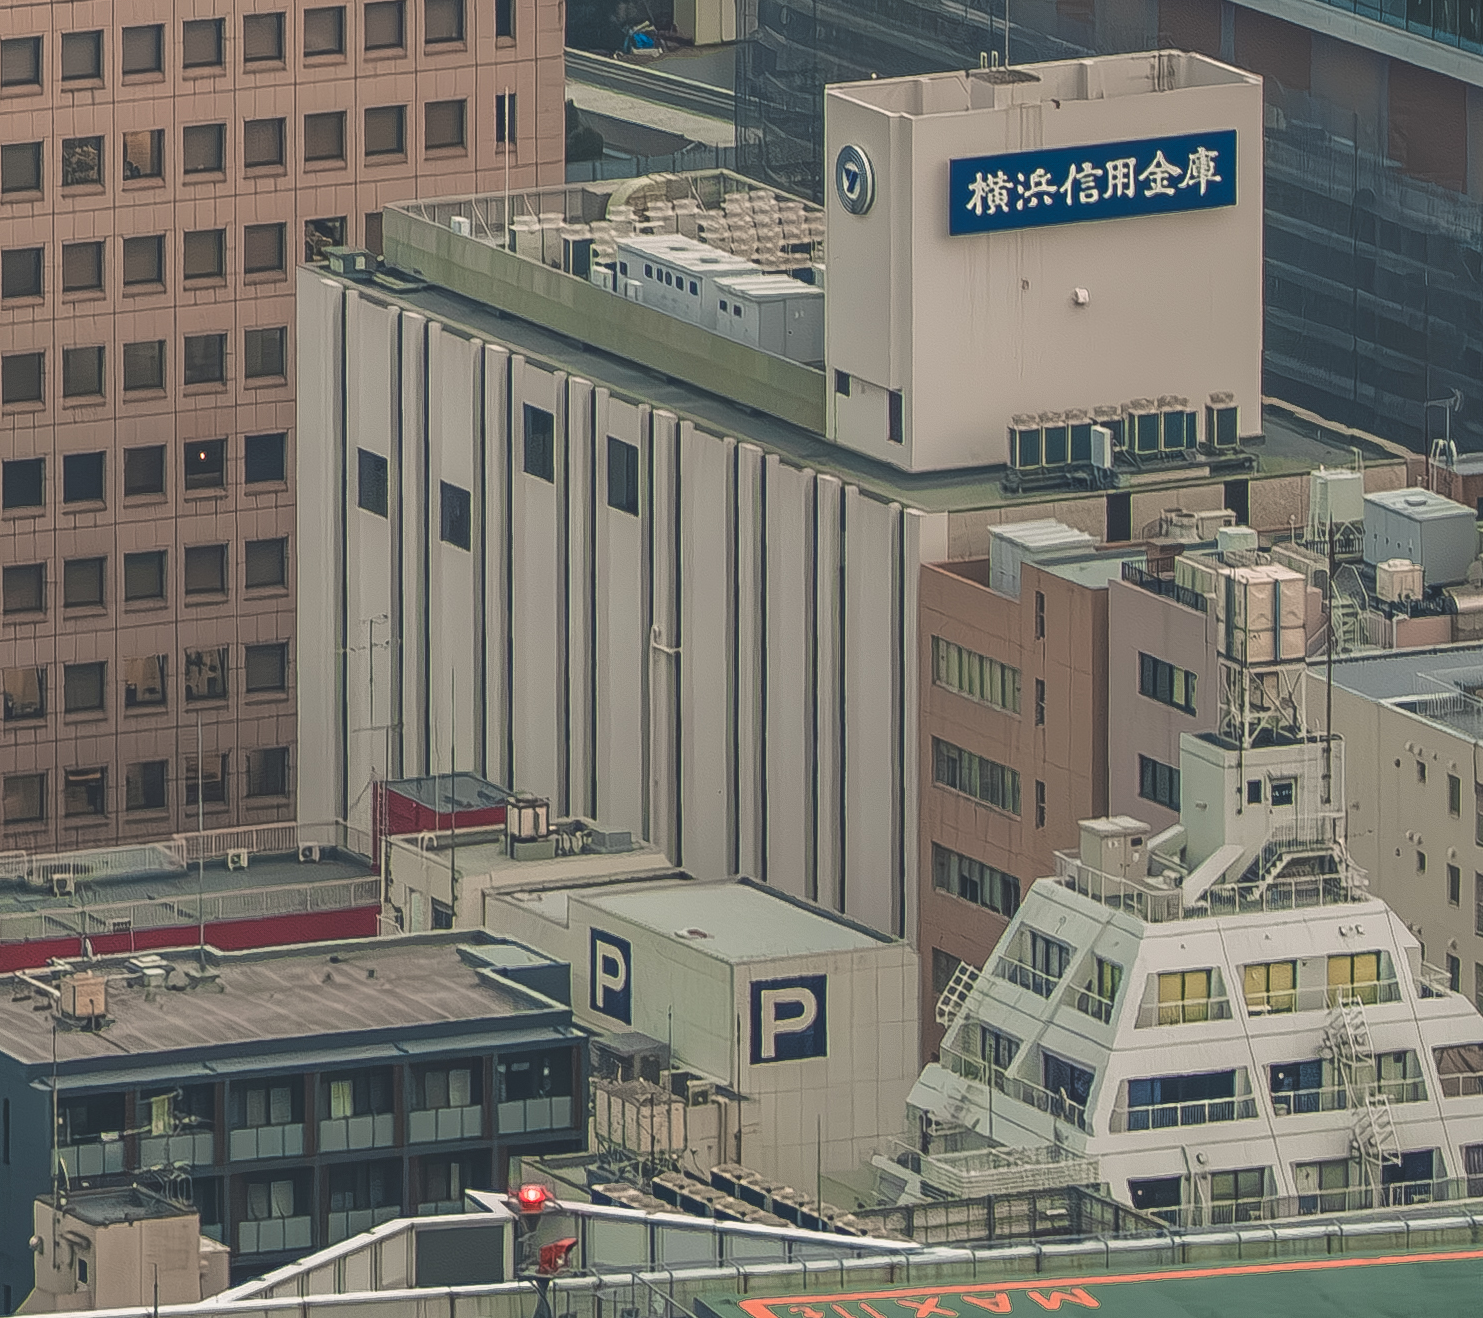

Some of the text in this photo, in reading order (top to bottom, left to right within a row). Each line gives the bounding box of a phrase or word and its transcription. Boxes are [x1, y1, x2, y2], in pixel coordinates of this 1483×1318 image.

[965, 147, 1223, 217] 横浜信用金庫
[596, 939, 627, 1008] P
[761, 987, 818, 1058] P
